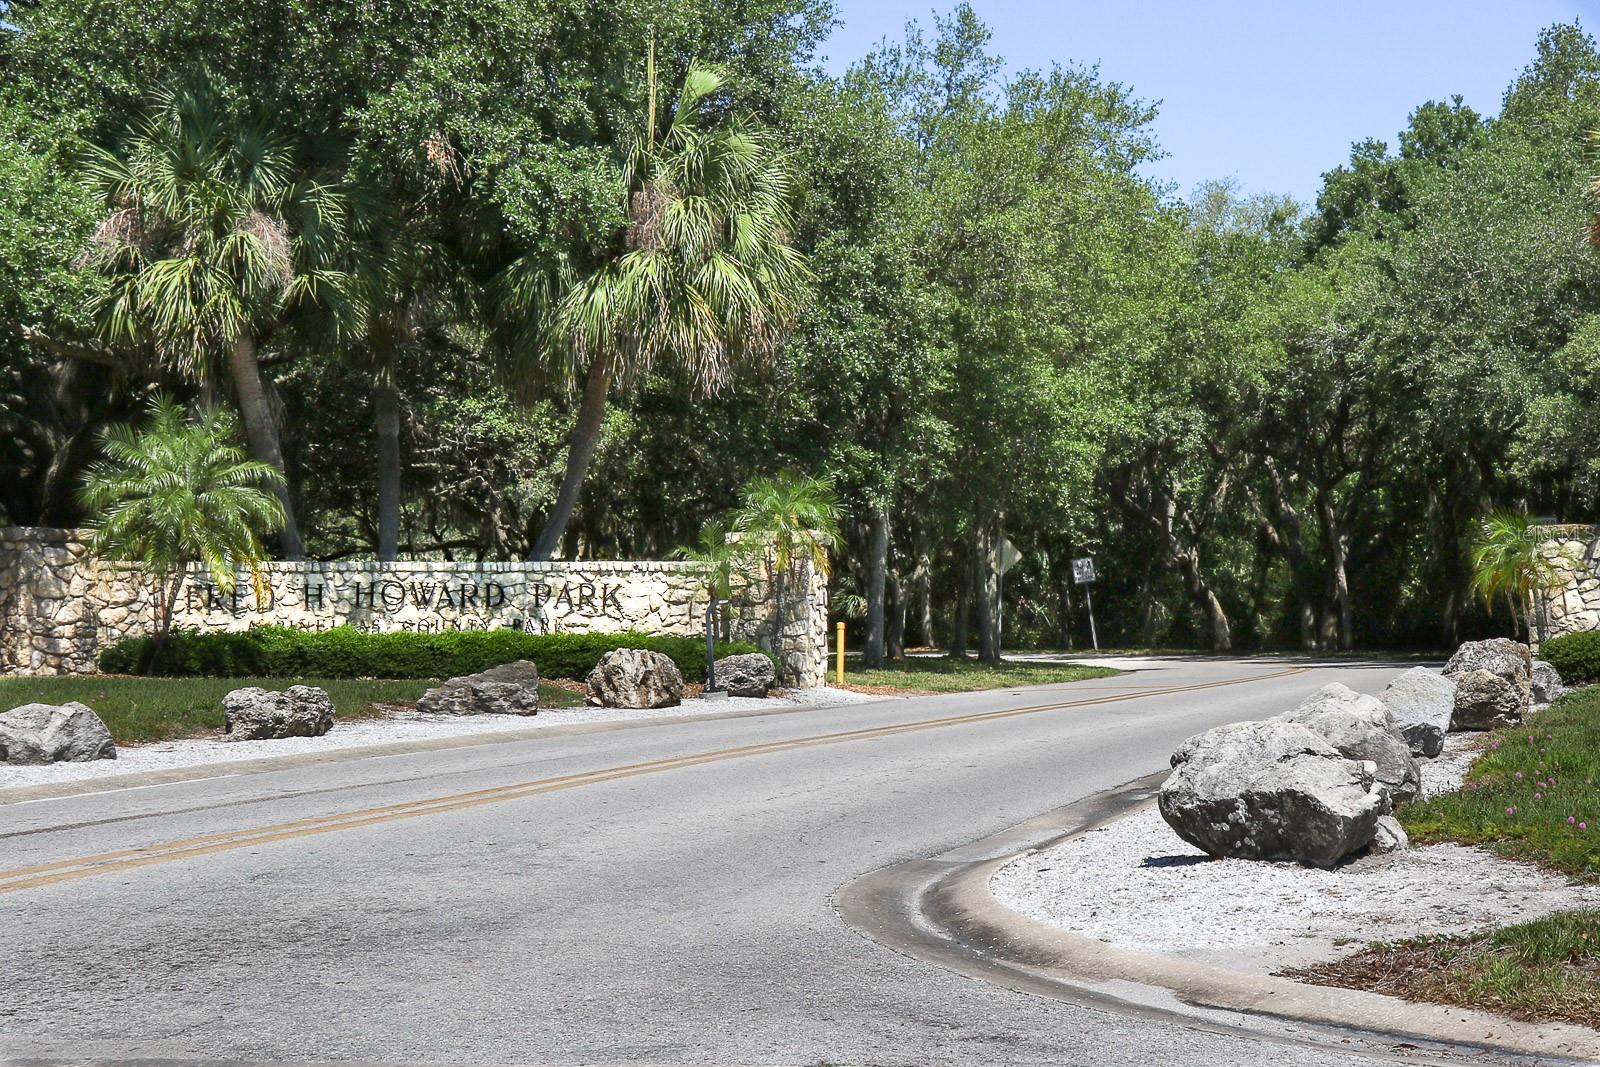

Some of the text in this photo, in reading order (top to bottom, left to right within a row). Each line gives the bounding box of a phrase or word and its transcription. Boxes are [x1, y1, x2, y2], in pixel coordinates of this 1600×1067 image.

[304, 583, 324, 612] H
[355, 580, 505, 612] HOWARD
[534, 581, 624, 617] PARK
